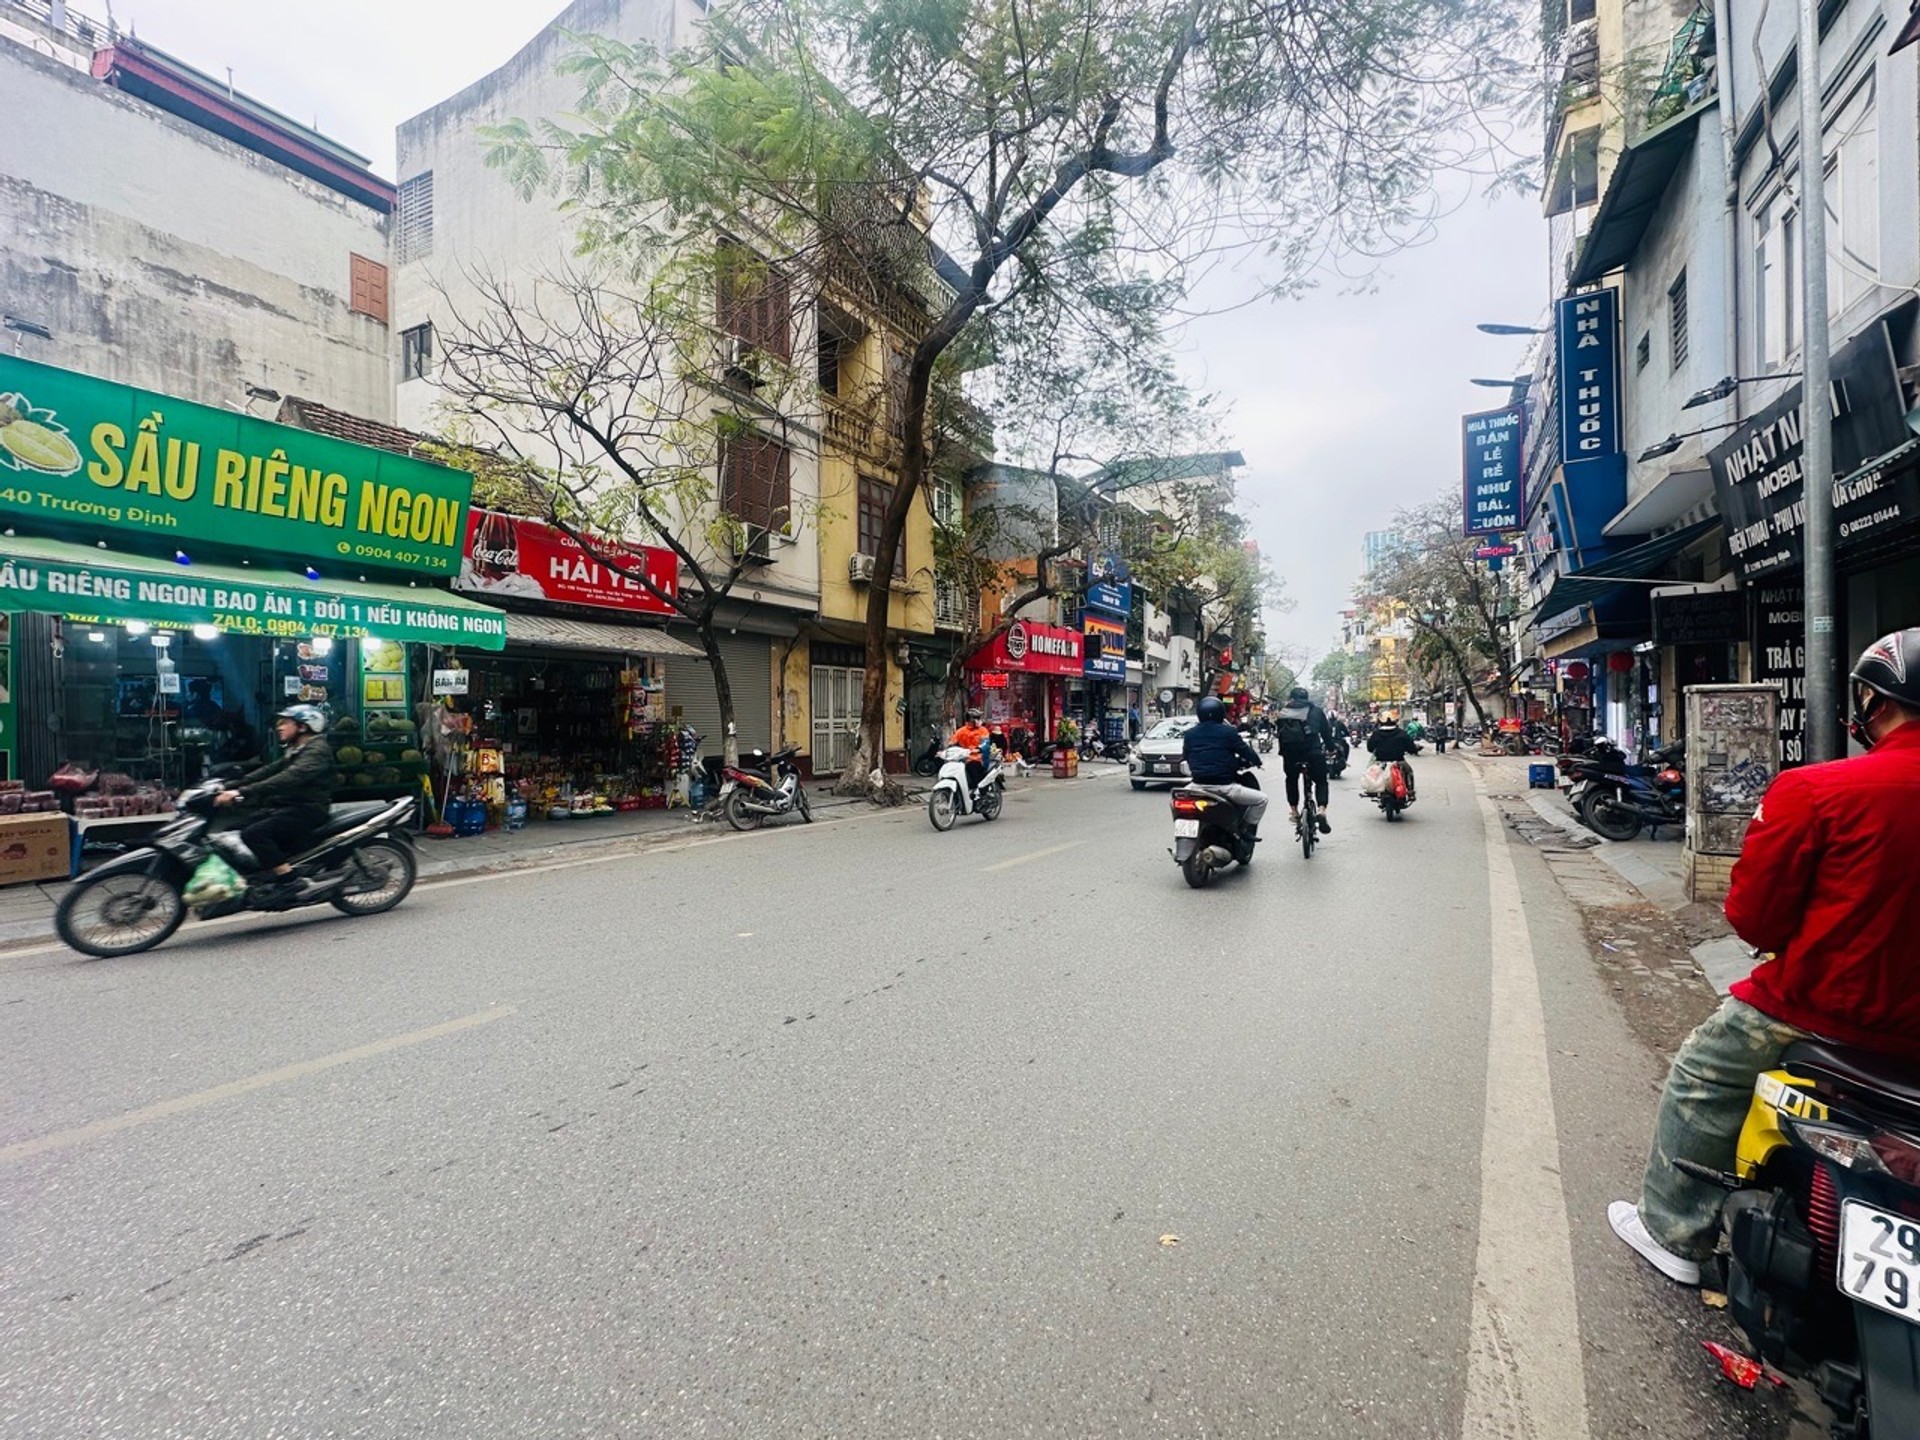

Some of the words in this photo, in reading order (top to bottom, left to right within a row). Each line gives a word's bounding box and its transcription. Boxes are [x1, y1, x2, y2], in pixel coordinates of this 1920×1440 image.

[1576, 299, 1600, 349] NHÀ
[1467, 418, 1487, 433] NHÀ
[1488, 412, 1519, 429] THUỐC
[1578, 369, 1602, 451] THUỐC
[1725, 423, 1778, 486] NHẬT
[87, 411, 201, 502] SẦU
[213, 449, 349, 529] RIÊNG
[357, 481, 460, 547] NGON
[1477, 480, 1512, 496] NHƯ
[0, 488, 32, 504] 40
[37, 492, 121, 520] Trương
[126, 509, 178, 527] Định
[1774, 506, 1795, 536] PHỤ
[1873, 504, 1901, 524] 01444
[355, 545, 392, 560] 0904
[395, 551, 421, 564] 407
[424, 556, 447, 568] 134
[550, 555, 599, 585] HẢI
[48, 570, 131, 601] RIÊNG
[139, 581, 206, 607] NGON
[213, 589, 257, 612] BAO
[263, 592, 293, 615] ĂN
[298, 599, 307, 617] 1
[314, 596, 346, 620] ĐỔI
[351, 604, 360, 622] 1
[367, 603, 402, 626] NẾU
[406, 609, 459, 631] KHÔNG
[462, 615, 503, 635] NGON
[212, 613, 262, 631] ZALO:
[266, 618, 306, 633] 0904
[311, 622, 339, 637] 407
[1766, 639, 1792, 668] TRẢ
[1780, 709, 1796, 730] AY
[1786, 732, 1802, 762] SỐ
[1853, 1251, 1920, 1316] 79
